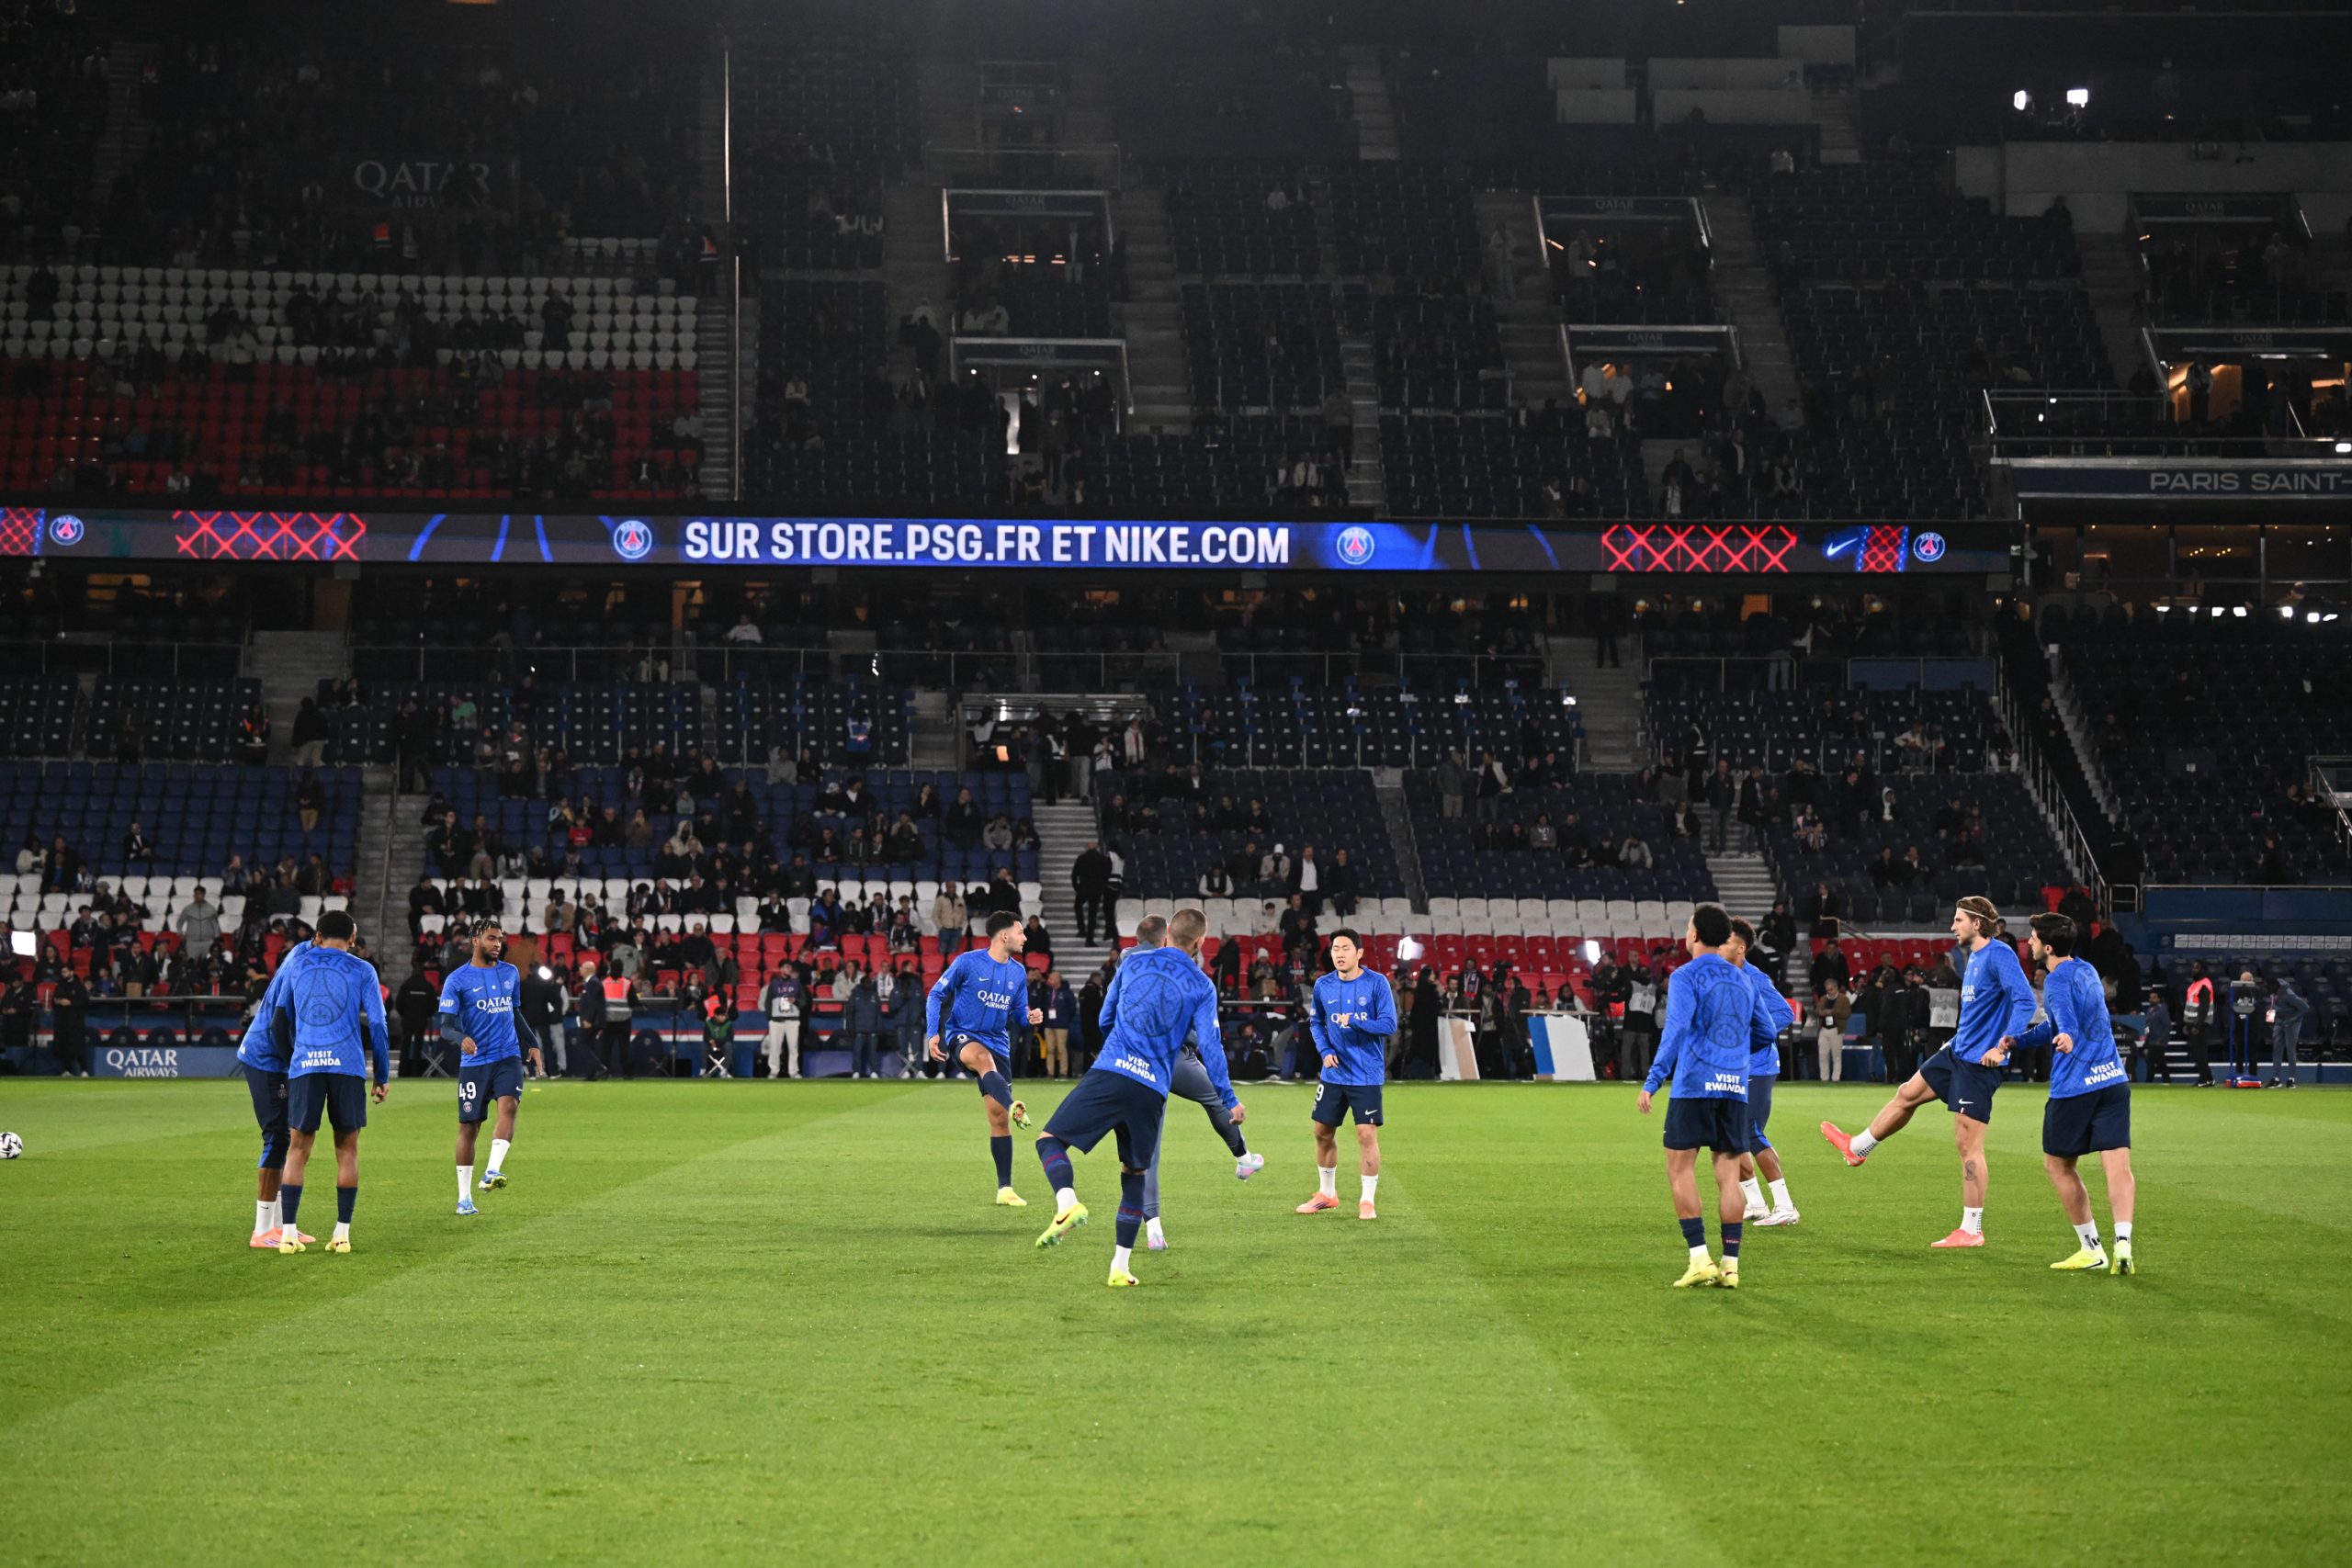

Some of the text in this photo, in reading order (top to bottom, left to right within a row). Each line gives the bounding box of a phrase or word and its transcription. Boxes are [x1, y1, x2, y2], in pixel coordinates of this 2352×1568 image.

[1595, 199, 1634, 210] QATAR
[2185, 202, 2224, 213] QATAR
[2150, 473, 2239, 491] PARIS
[684, 522, 1289, 564] SUR STORE.PSG.FR ET NIKE.COM
[1129, 957, 1197, 993] PARIS
[476, 997, 513, 1011] QATAR
[978, 989, 1011, 1005] QATAR
[1330, 1011, 1368, 1024] QAR
[107, 1049, 177, 1070] QATAR
[307, 1051, 333, 1059] VISIT
[1127, 1054, 1150, 1070] VISIT
[124, 1067, 178, 1077] AIRWAYS
[1114, 1058, 1157, 1083] RWANDA
[2090, 1061, 2115, 1075] VISIT
[1715, 1073, 1740, 1084] VISIT
[458, 1081, 477, 1100] 49
[1704, 1081, 1746, 1095] RWANDA
